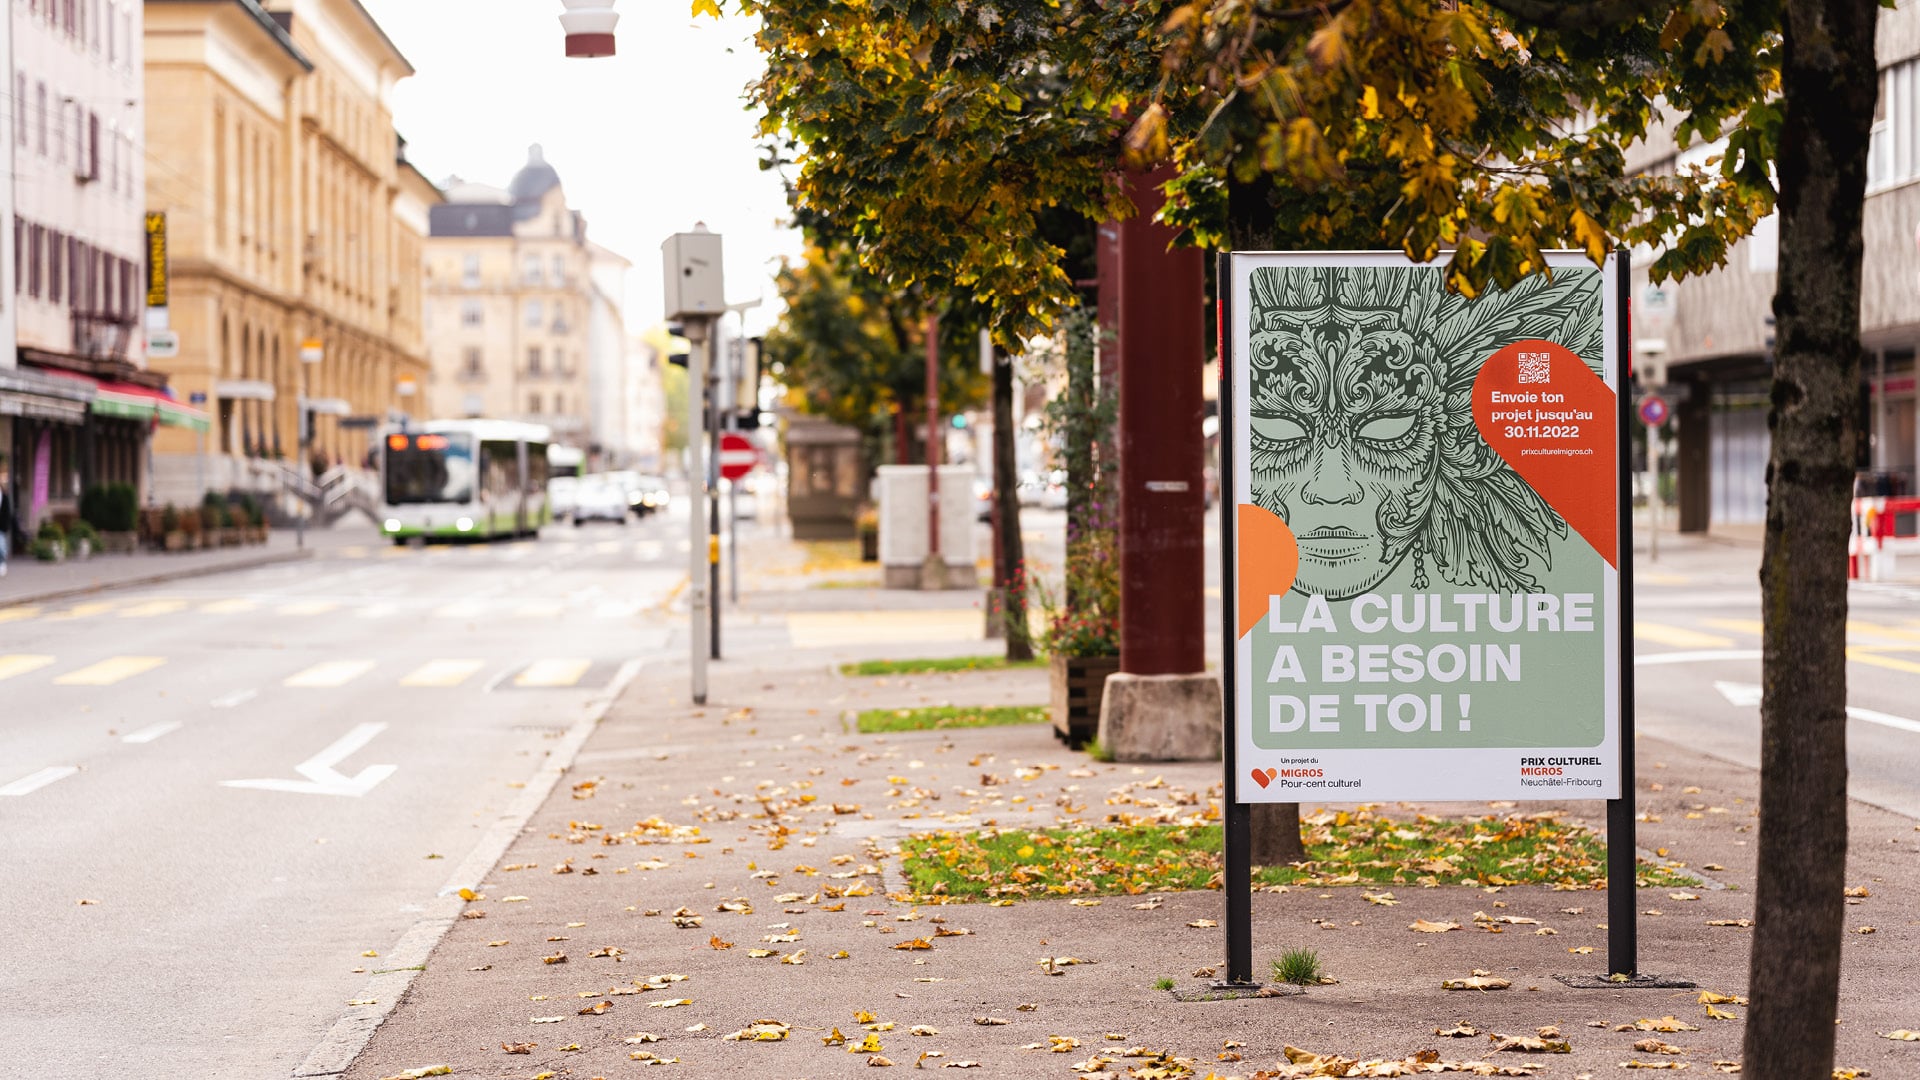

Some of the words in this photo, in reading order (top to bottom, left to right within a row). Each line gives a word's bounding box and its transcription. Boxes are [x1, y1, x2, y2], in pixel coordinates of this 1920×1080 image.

[1491, 391, 1538, 403] Envoie
[1541, 391, 1564, 403] ton
[1491, 409, 1532, 422] projet
[1535, 409, 1593, 422] jusqu'au
[1504, 426, 1580, 438] 30.11.2022
[1521, 448, 1593, 456] prixculturelmigros.ch
[1268, 594, 1338, 633] LA
[1350, 593, 1595, 633] CULTURE
[1267, 645, 1307, 683] A
[1321, 644, 1521, 683] BESOIN
[1269, 695, 1340, 733] DE
[1354, 694, 1442, 733] TOI
[1458, 694, 1471, 732] !
[1291, 757, 1309, 765] projet
[1521, 757, 1545, 765] PRIX
[1548, 757, 1602, 765] CULTUREL
[1281, 769, 1324, 778] MIGROS
[1521, 767, 1563, 775] MIGROS
[1281, 779, 1326, 788] Pour-cent
[1328, 779, 1361, 788] culturel
[1521, 778, 1602, 787] Neuchâtel-Fribourg
